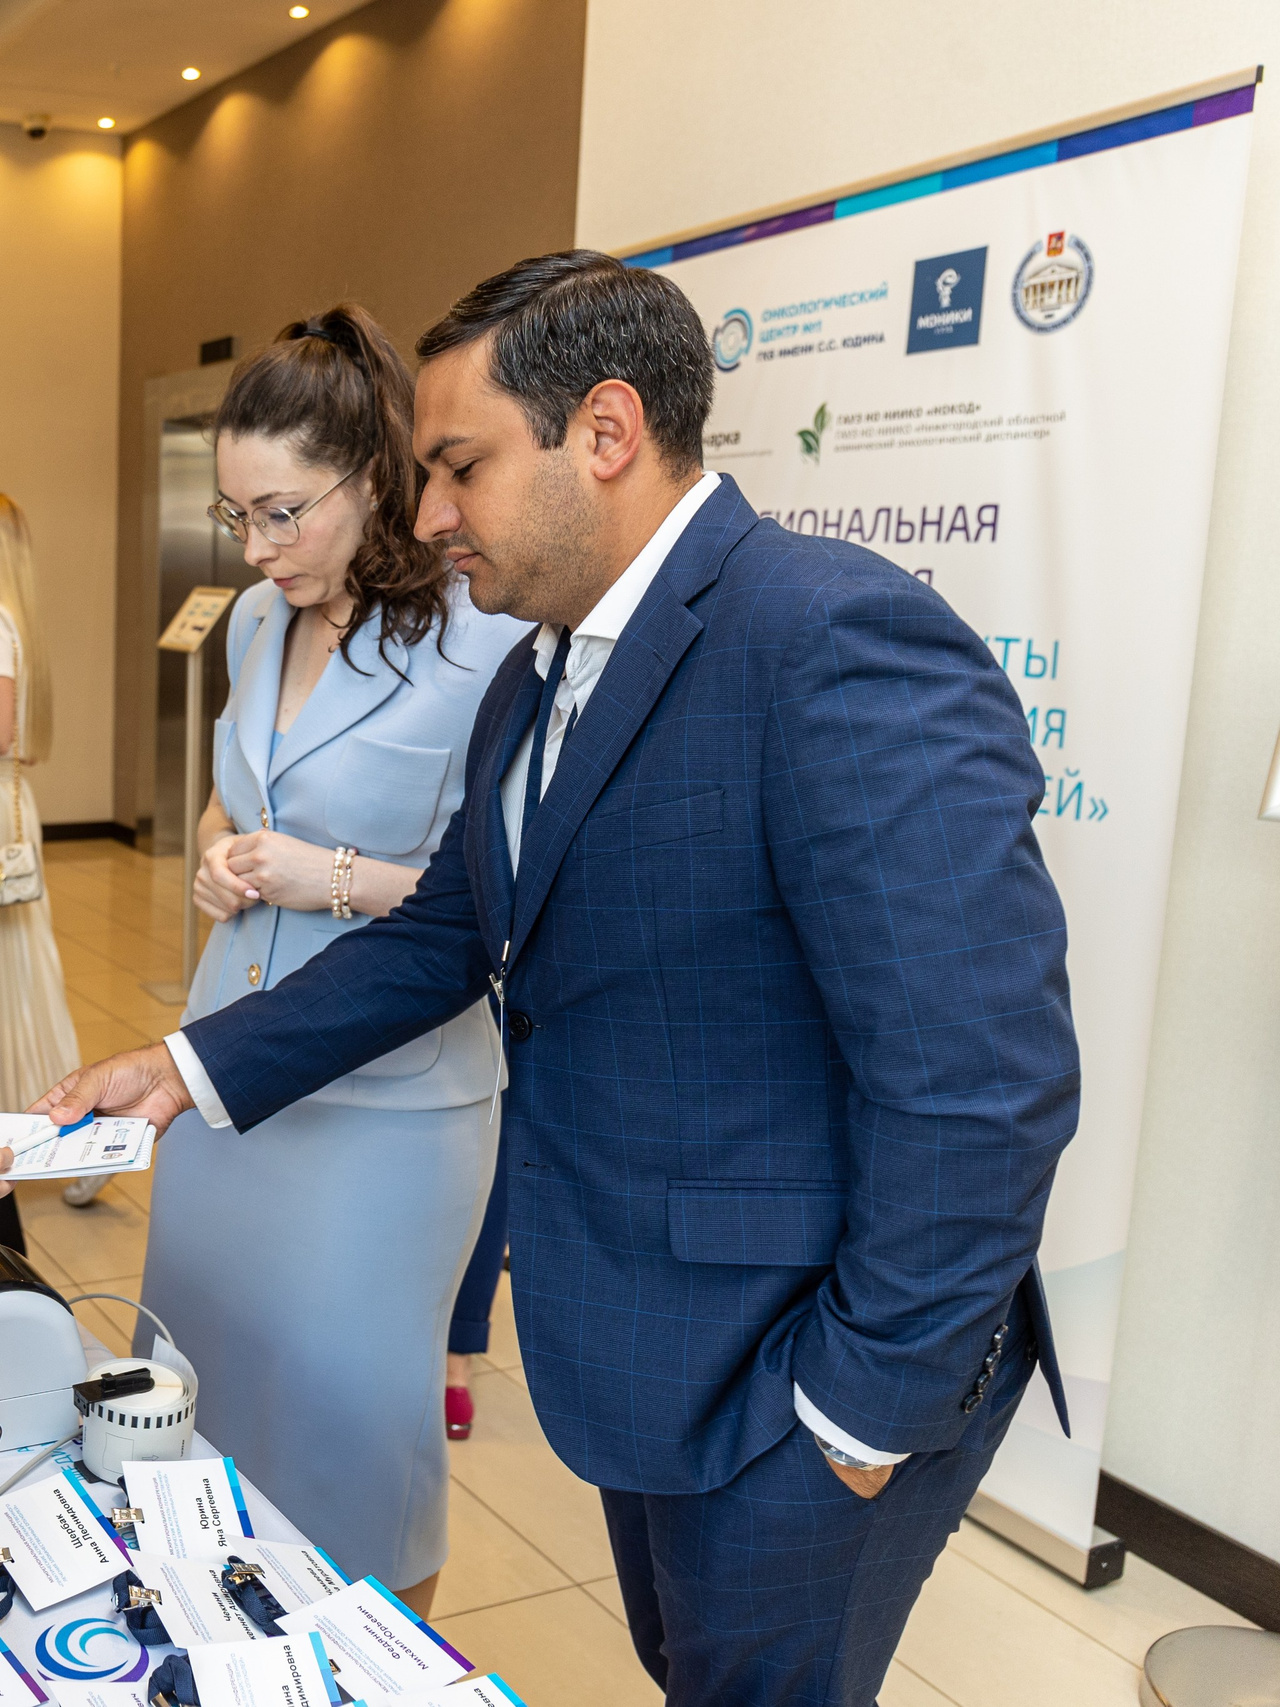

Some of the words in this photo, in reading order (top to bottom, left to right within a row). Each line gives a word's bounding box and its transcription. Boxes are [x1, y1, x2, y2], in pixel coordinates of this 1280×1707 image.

[761, 281, 889, 323] ОНКОЛОГИЧЕСКИЙ
[759, 323, 799, 344] ЦЕНТР
[53, 1488, 93, 1541] Леонидовна
[195, 1497, 210, 1530] Юрина
[202, 1478, 221, 1527] Сергеевна
[56, 1513, 83, 1549] Щербак
[216, 1528, 228, 1547] Яна
[89, 1541, 109, 1564] Анна
[356, 1605, 396, 1640] Юрьевич
[363, 1624, 401, 1660] Федянин
[394, 1639, 429, 1670] Михаил
